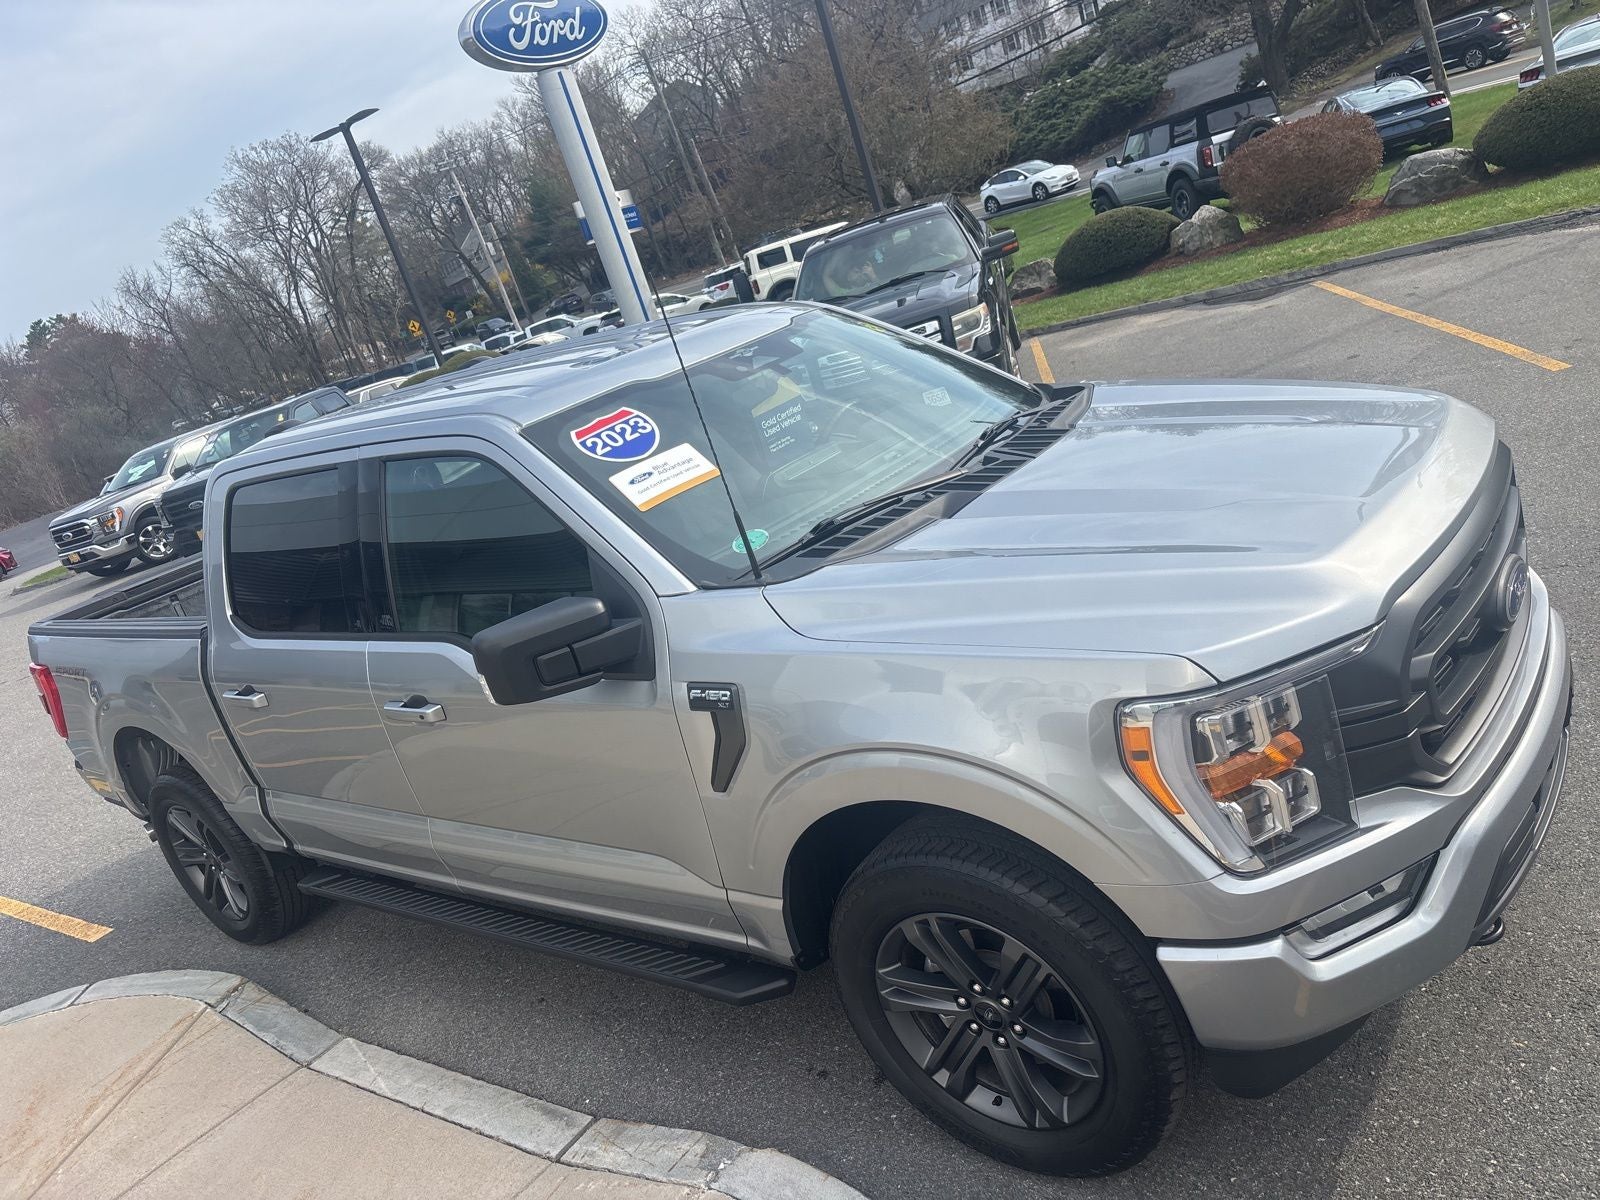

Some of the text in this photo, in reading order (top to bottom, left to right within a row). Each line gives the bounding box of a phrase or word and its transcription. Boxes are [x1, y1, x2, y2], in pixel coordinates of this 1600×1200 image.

[508, 0, 586, 50] Ford
[761, 403, 802, 429] Gold Certified
[763, 413, 802, 437] Used Vehicle
[585, 417, 653, 456] 2023
[652, 461, 669, 472] Blue
[657, 457, 694, 476] Advantage
[690, 690, 730, 700] F-150
